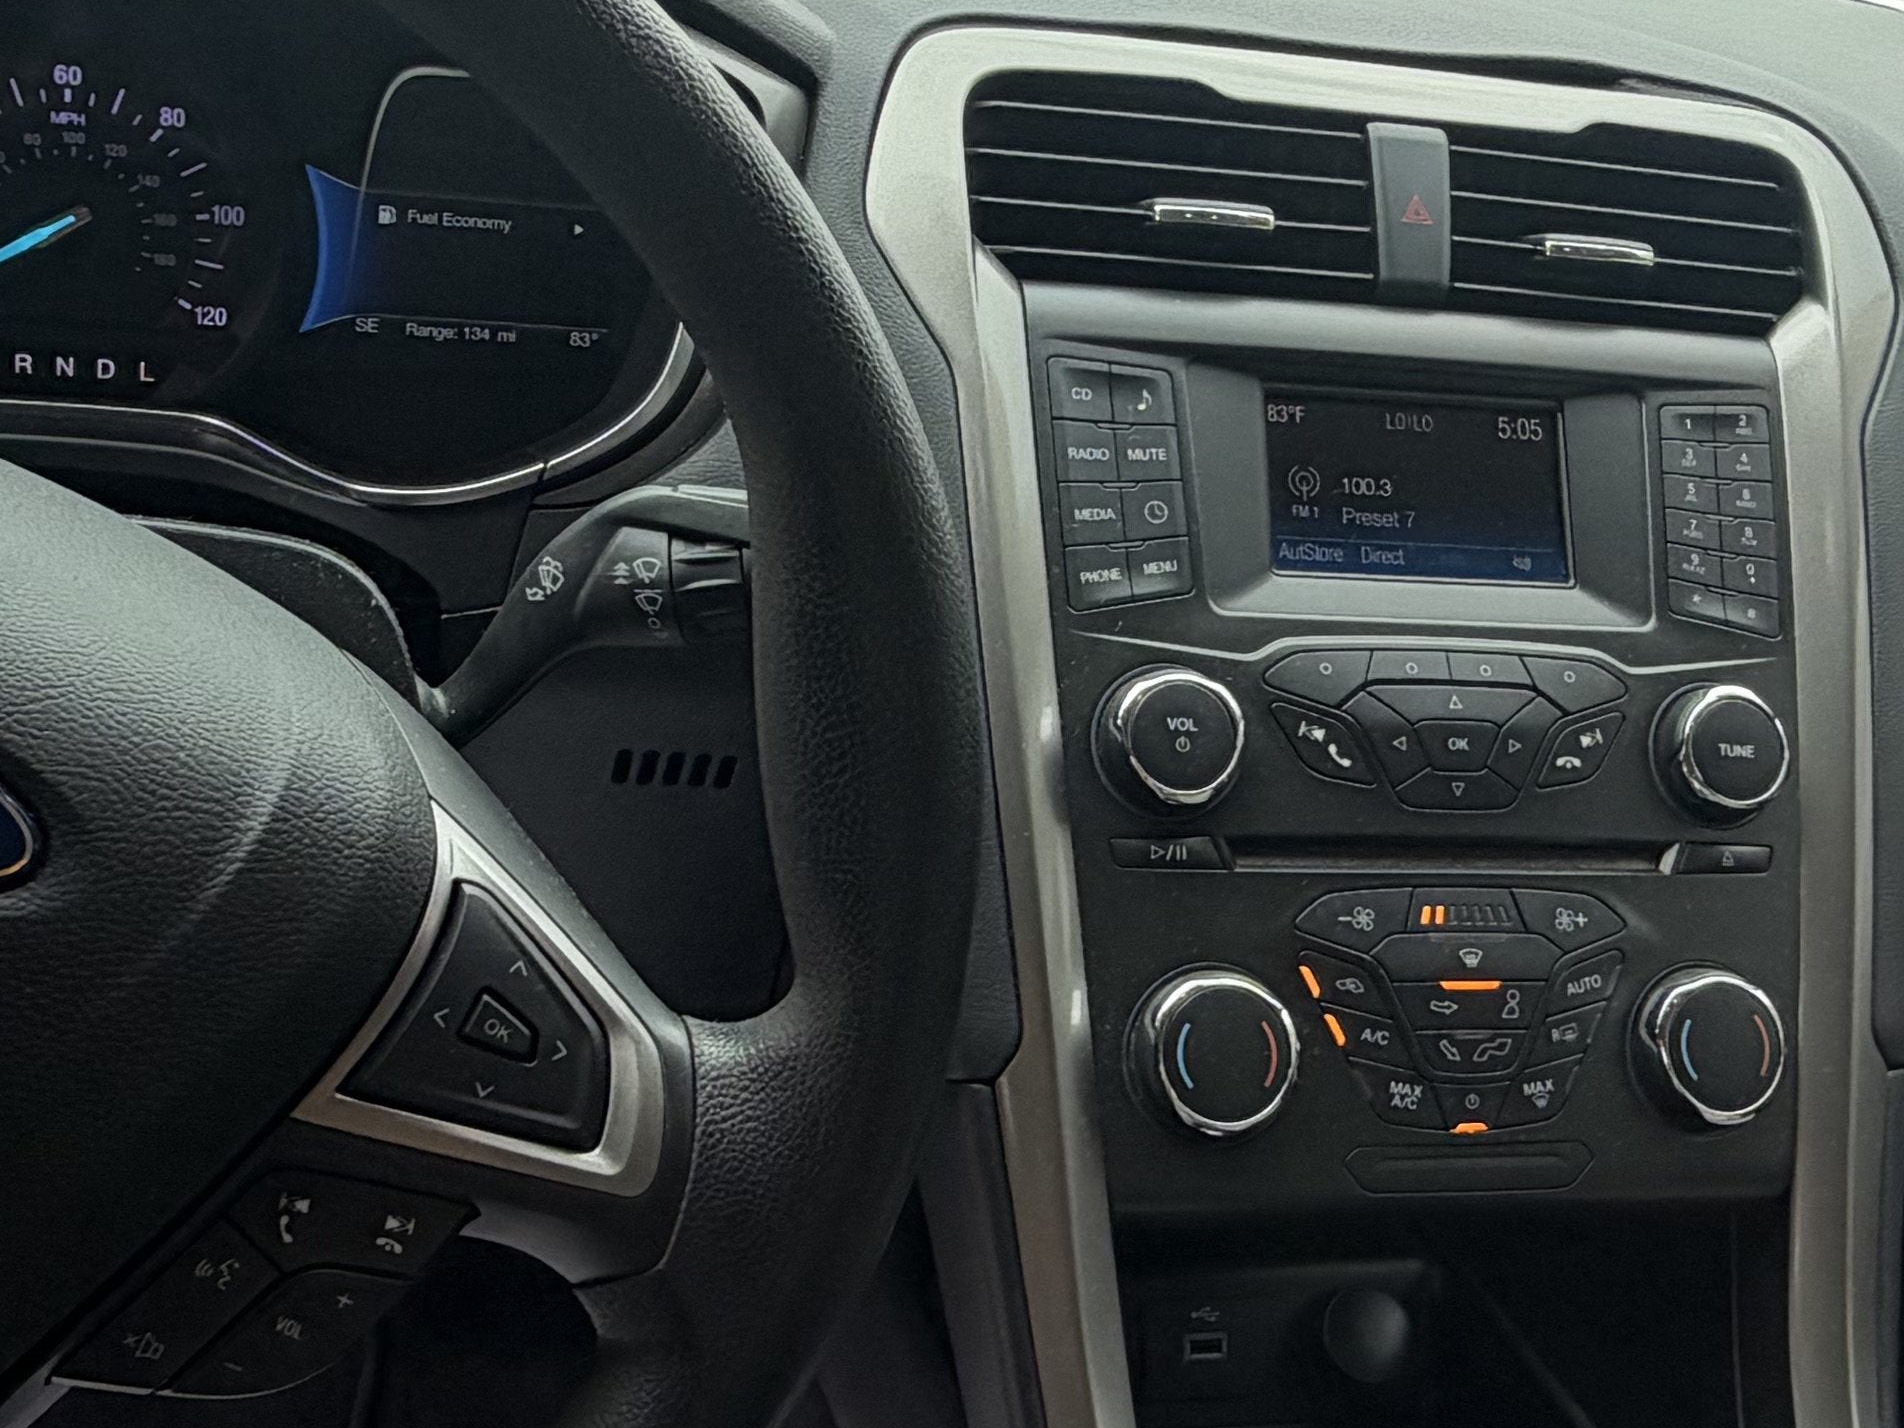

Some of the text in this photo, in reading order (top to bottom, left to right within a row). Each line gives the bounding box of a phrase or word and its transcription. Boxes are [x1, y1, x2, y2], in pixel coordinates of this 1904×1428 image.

[53, 63, 83, 86] 60
[50, 110, 86, 126] MPH
[159, 106, 186, 128] 80
[211, 205, 245, 226] 100
[407, 209, 512, 234] Fuel Economy
[195, 306, 227, 327] 120
[355, 317, 381, 334] SE
[406, 323, 517, 343] Range: 134 mi
[14, 354, 32, 374] R
[56, 357, 75, 378] N
[97, 358, 115, 380] D
[140, 361, 155, 382] L
[1071, 387, 1093, 401] CD
[1498, 417, 1543, 441] 5:05
[1068, 447, 1110, 461] RADIO
[1127, 448, 1167, 461] MUTE
[1342, 477, 1393, 497] 100.3
[1074, 507, 1116, 522] MEDIA
[1342, 507, 1416, 528] Preset 7
[1360, 545, 1406, 566] Direct
[1080, 567, 1123, 585] PHONE
[1143, 559, 1178, 575] MENU
[1166, 717, 1199, 733] VOL
[1447, 737, 1470, 752] OK
[1718, 743, 1755, 759] TUNE
[1567, 974, 1602, 996] AUTO
[483, 1018, 513, 1043] OK
[1361, 1028, 1390, 1045] A/C
[1389, 1081, 1423, 1098] MAX
[1523, 1079, 1555, 1096] MAX
[1390, 1095, 1418, 1109] A/C
[275, 1315, 303, 1340] VOL
